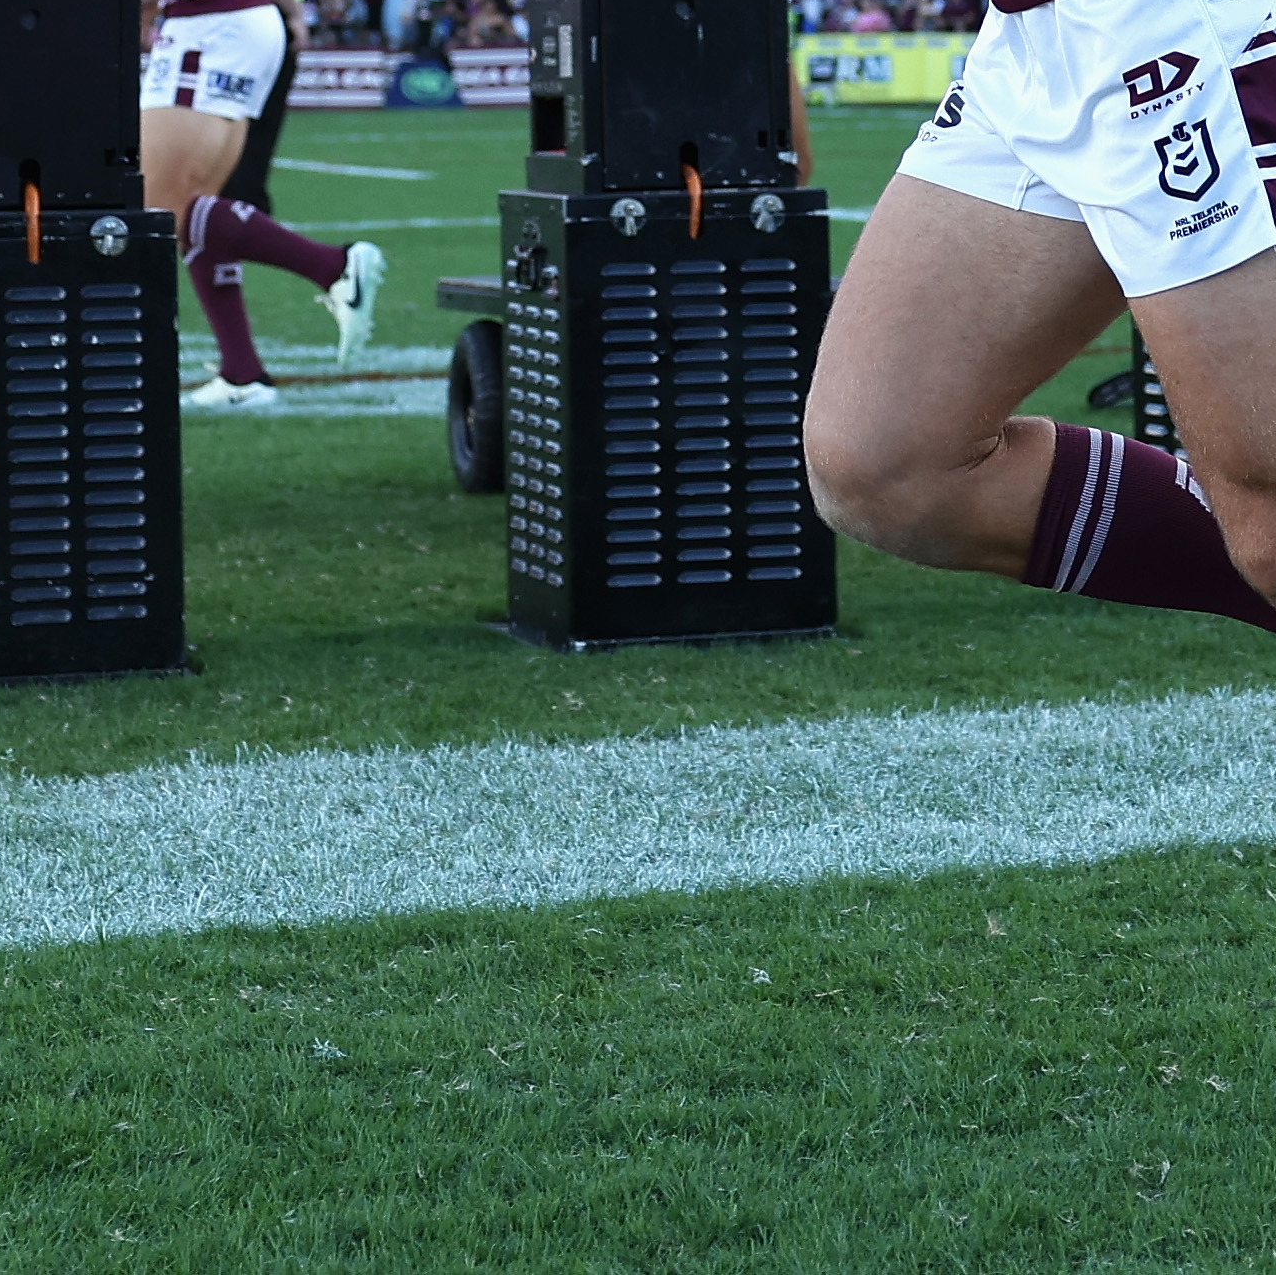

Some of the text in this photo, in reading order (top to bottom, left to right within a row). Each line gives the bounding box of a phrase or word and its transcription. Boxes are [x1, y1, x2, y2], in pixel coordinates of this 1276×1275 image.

[1129, 81, 1205, 121] DYNASTY
[1169, 204, 1239, 240] PREMIERSHIP
[1174, 200, 1228, 228] NRL TELSTRA
